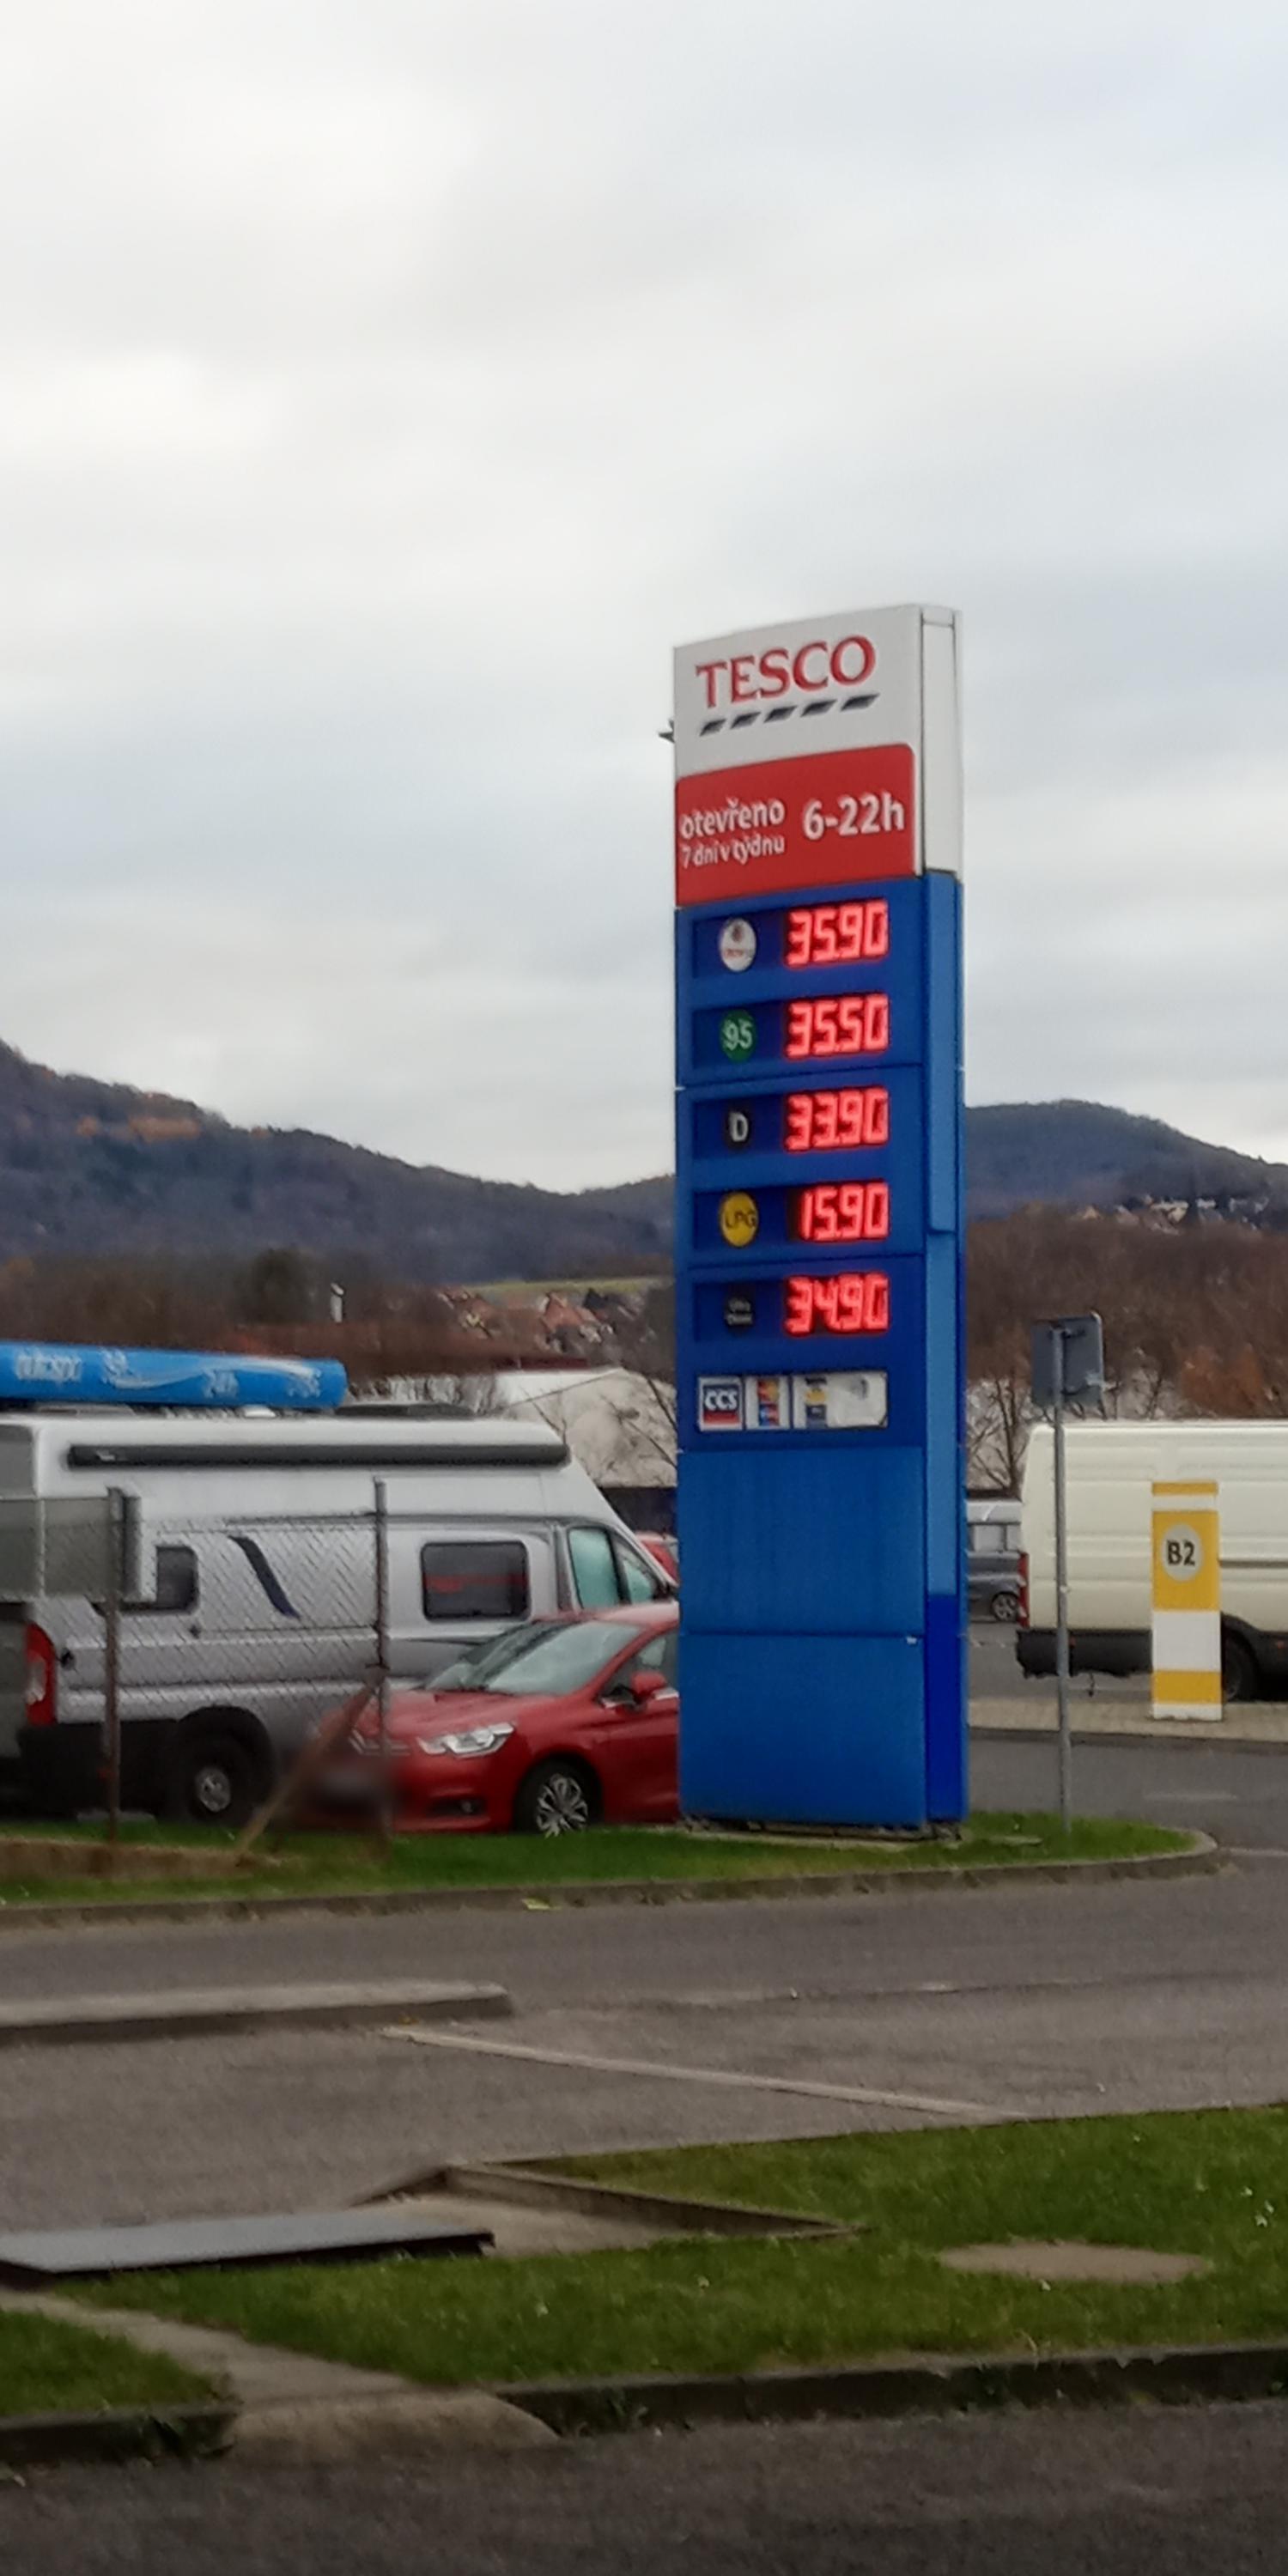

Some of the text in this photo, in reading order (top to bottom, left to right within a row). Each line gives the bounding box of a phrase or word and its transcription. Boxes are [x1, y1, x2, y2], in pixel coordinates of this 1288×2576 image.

[695, 635, 876, 708] TESCO
[679, 797, 785, 840] otevřeno
[803, 789, 905, 841] 6-22h
[680, 844, 691, 869] 7
[720, 844, 730, 862] v
[732, 831, 785, 866] týdnu
[722, 1018, 753, 1052] 95
[730, 1111, 749, 1143] D
[724, 1210, 756, 1229] LPG
[704, 1389, 738, 1411] CCS
[1166, 1540, 1196, 1566] B2
